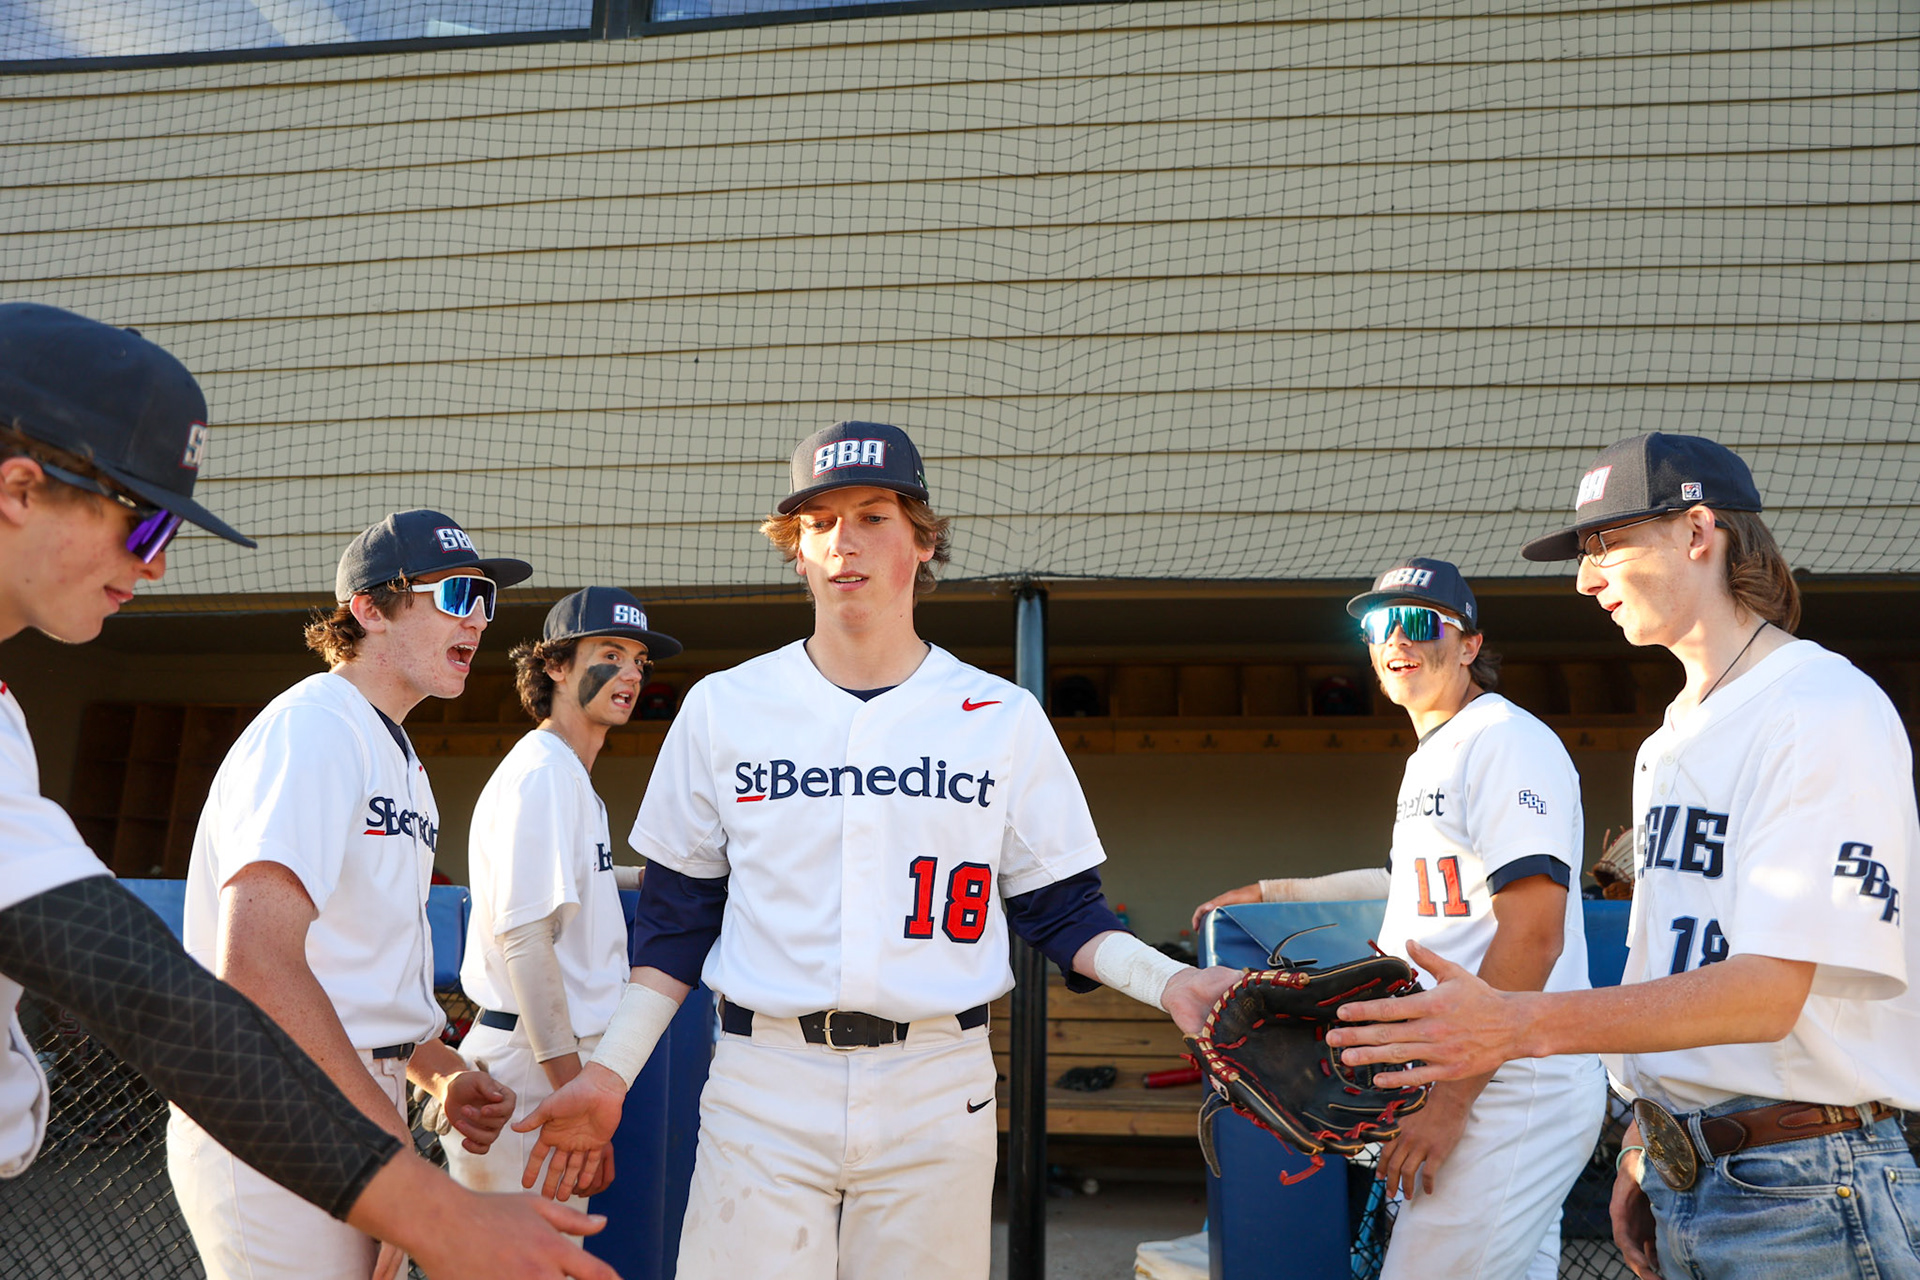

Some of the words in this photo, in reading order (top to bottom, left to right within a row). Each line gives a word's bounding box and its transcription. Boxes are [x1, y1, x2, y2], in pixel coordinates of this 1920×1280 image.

[813, 438, 886, 478] SBA
[434, 526, 479, 556] SB
[612, 603, 648, 631] SBA
[735, 757, 996, 807] StBenedict
[1519, 789, 1548, 815] SBA
[904, 855, 992, 944] 18
[1415, 855, 1471, 917] 11
